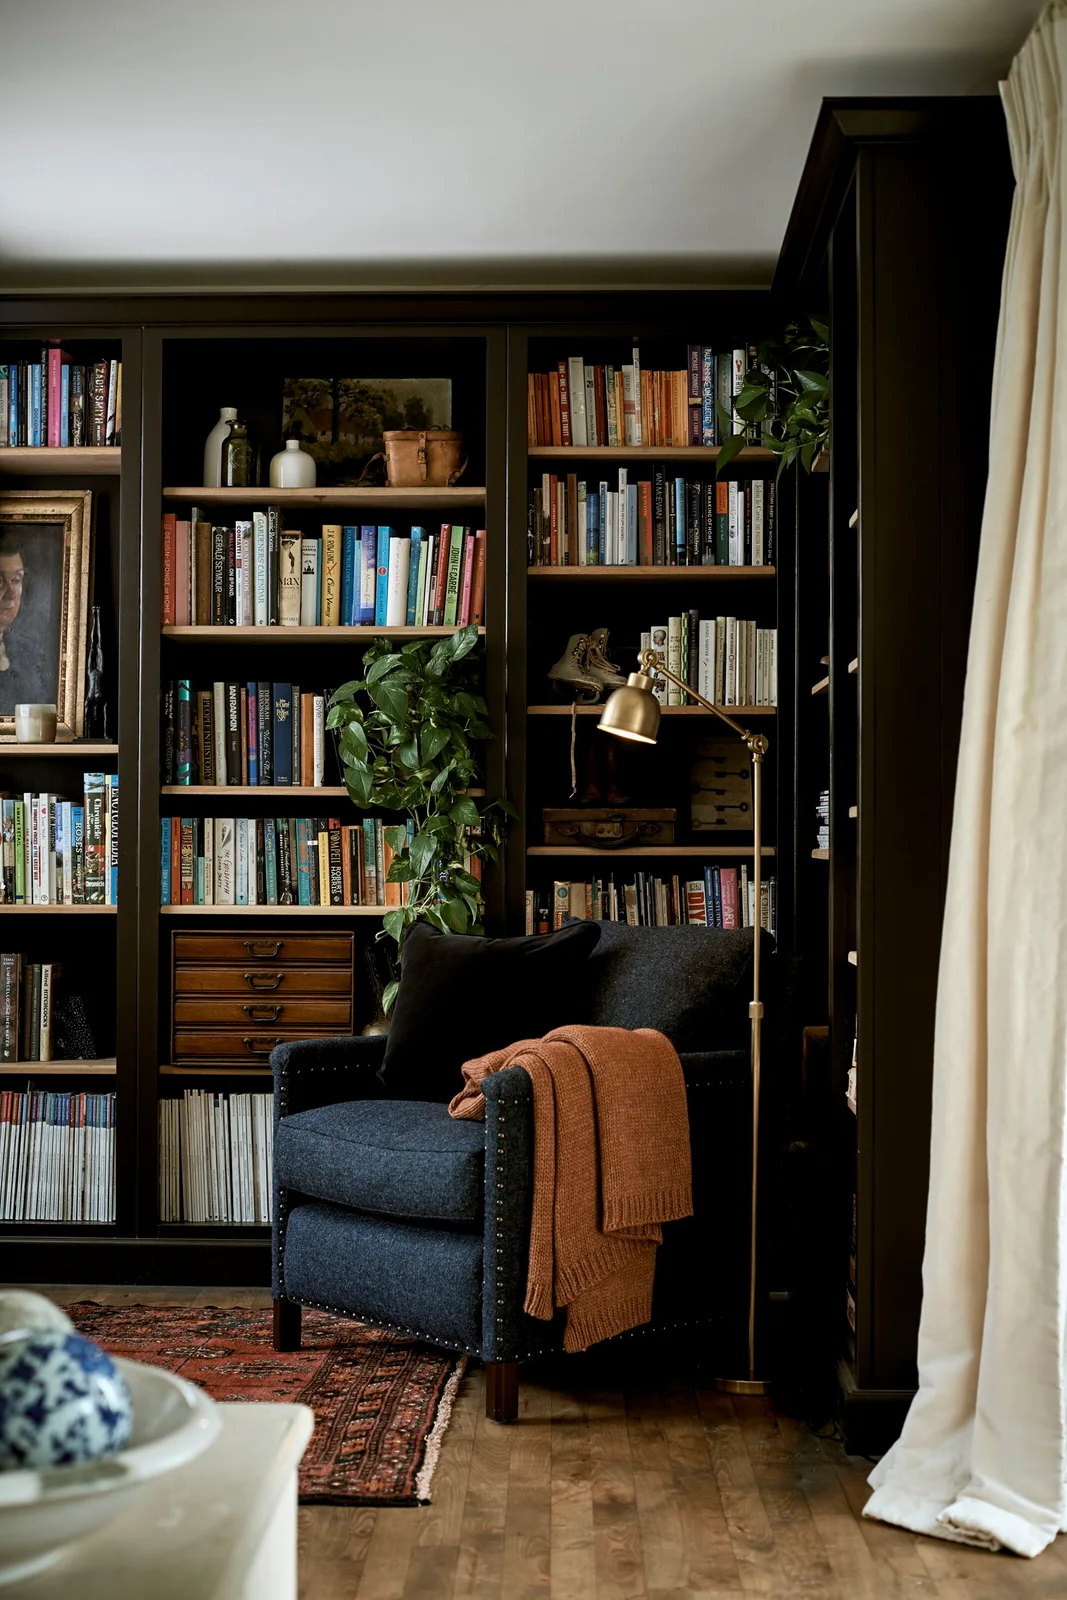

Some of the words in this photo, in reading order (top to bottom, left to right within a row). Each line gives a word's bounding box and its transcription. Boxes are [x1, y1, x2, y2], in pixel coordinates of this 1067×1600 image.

[704, 349, 712, 361] PAUL
[95, 368, 104, 393] ZADIE
[624, 375, 632, 392] prep
[95, 395, 104, 424] SMITH
[707, 518, 712, 526] OF
[215, 534, 223, 560] GERALD
[451, 546, 459, 564] JOHN
[215, 561, 223, 592] SEYMOUR
[229, 568, 234, 576] ON
[448, 572, 458, 595] CARRÉ
[229, 685, 237, 699] IAN
[315, 700, 323, 718] Style
[204, 730, 211, 739] IN
[94, 798, 102, 839] Chronicle
[182, 824, 192, 849] ZADIE
[330, 830, 341, 864] POMPEII
[182, 851, 193, 877] SMITH
[688, 892, 706, 921] DIY
[724, 906, 735, 927] ART
